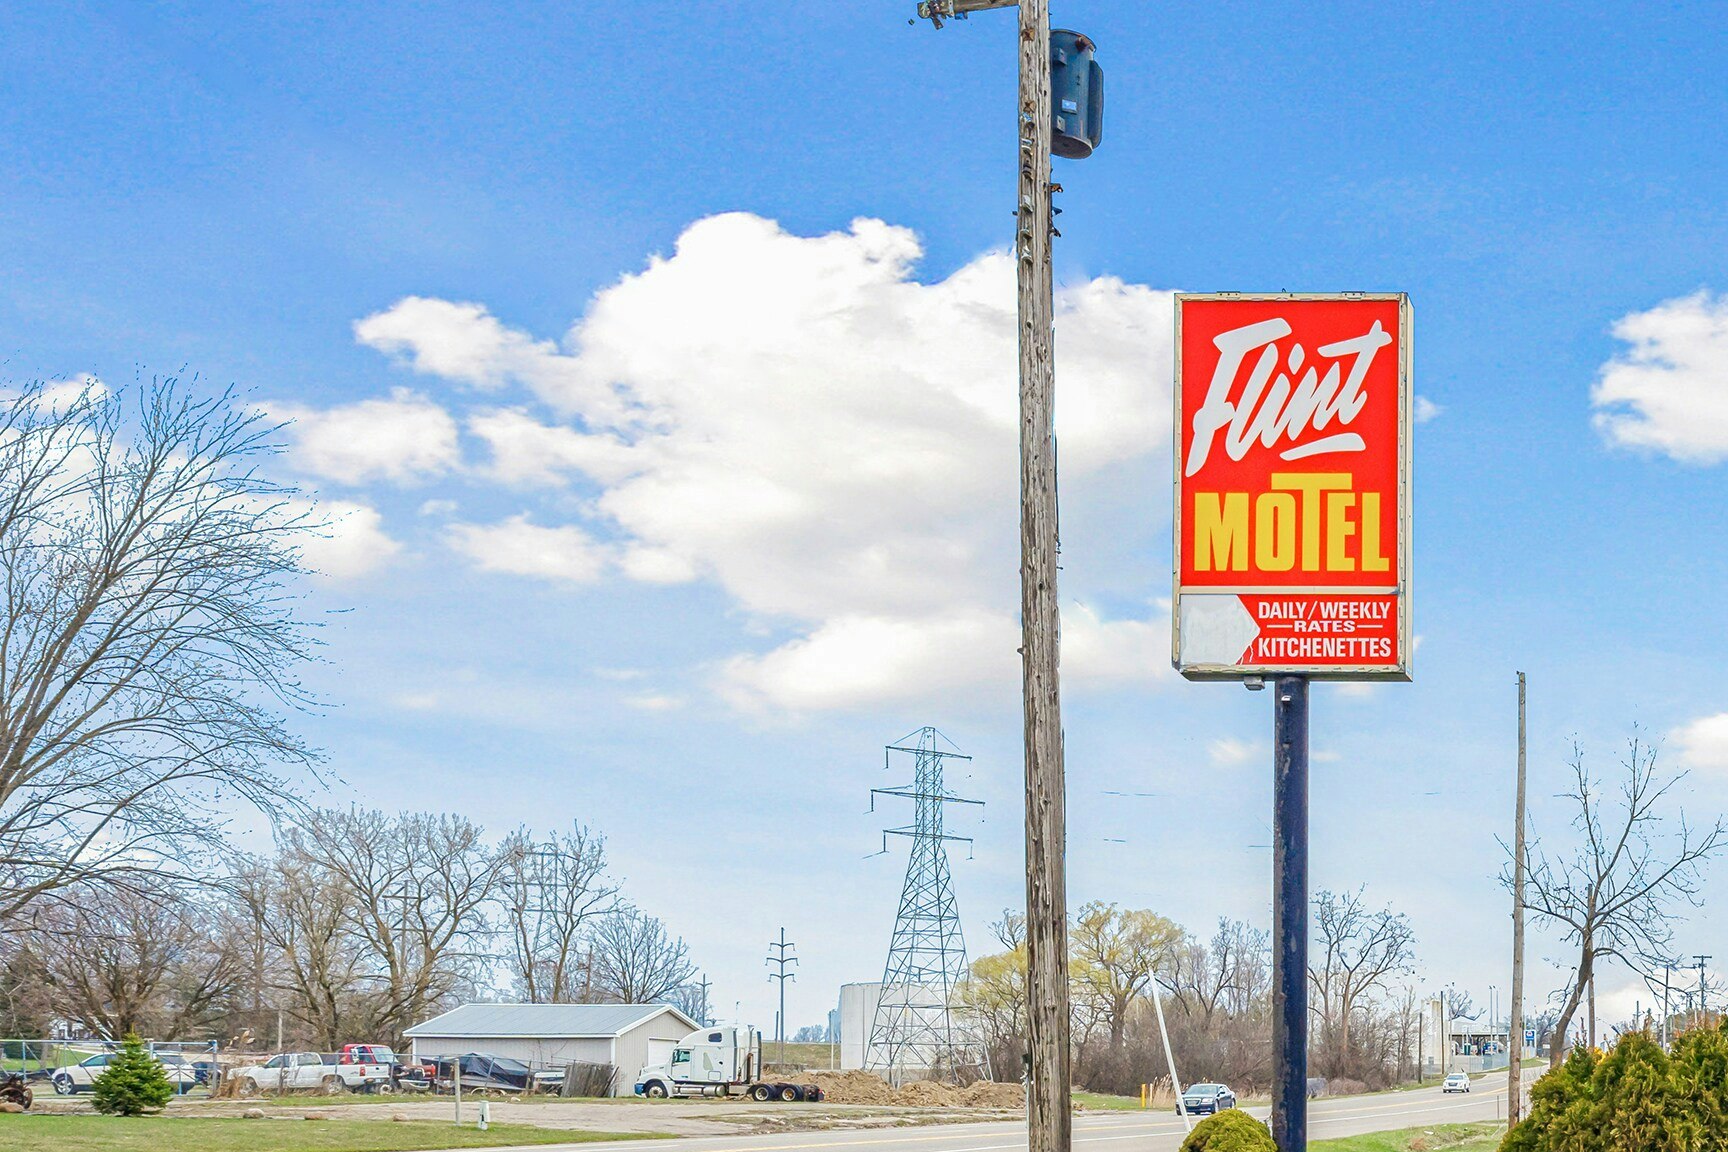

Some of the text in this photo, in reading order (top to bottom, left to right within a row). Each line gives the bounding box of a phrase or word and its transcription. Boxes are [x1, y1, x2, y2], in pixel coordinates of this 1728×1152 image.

[1185, 317, 1393, 477] Flint
[1194, 472, 1390, 572] MOTEL
[1258, 637, 1391, 658] KITCHENETTES
[1293, 620, 1356, 633] RATES
